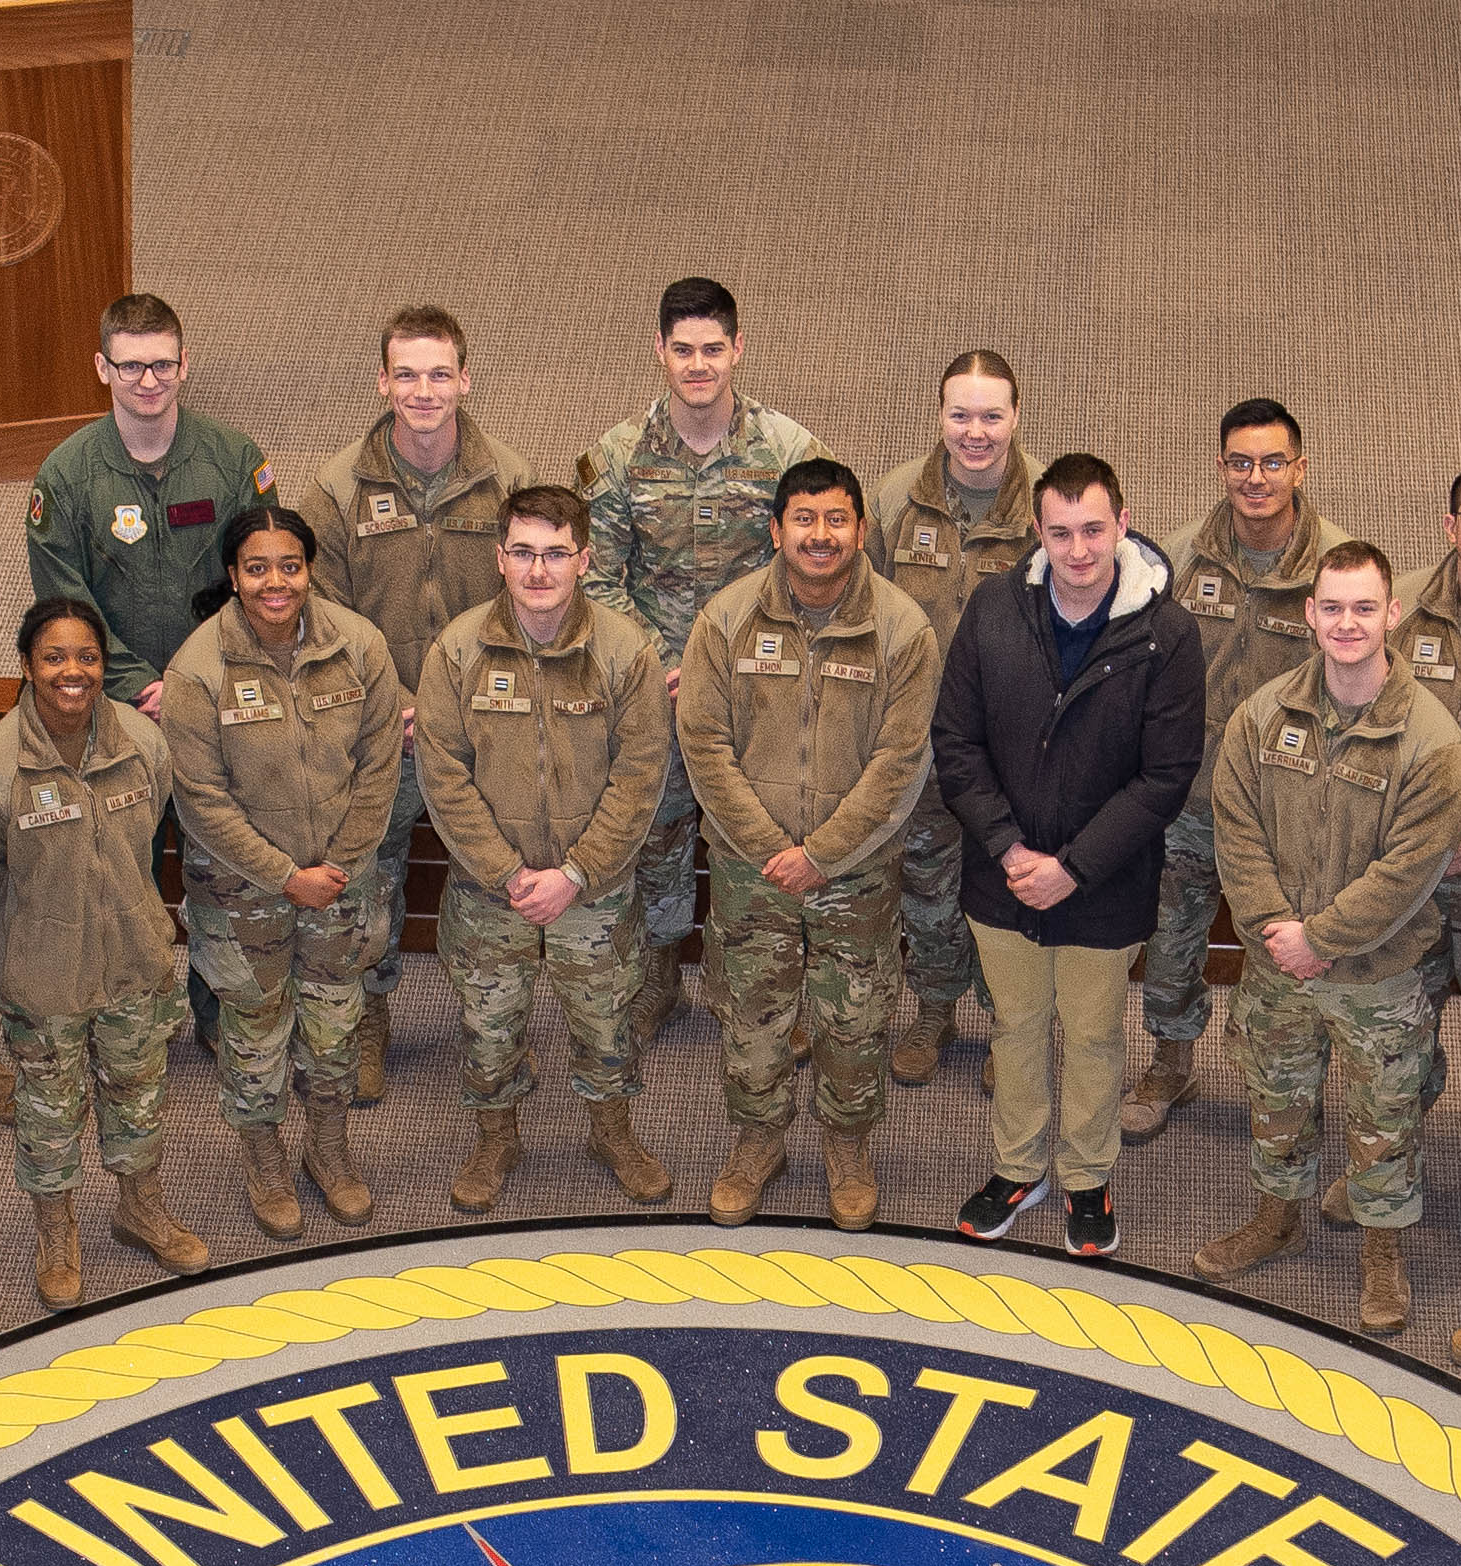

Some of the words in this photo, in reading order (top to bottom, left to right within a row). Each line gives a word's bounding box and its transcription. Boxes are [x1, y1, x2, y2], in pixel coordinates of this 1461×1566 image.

[365, 517, 408, 534] SCROGGINS
[1190, 602, 1226, 616] MONTIEL
[1258, 616, 1271, 627] U.S.
[1272, 620, 1285, 631] AIR
[1285, 623, 1308, 637] FORCE
[755, 661, 783, 673] LEMON
[835, 666, 848, 676] AIR
[849, 667, 872, 680] FORCE
[316, 696, 329, 708] U.S.
[330, 694, 343, 705] AIR
[344, 689, 363, 704] FORCE
[489, 698, 514, 710] SMITH
[233, 707, 269, 722] WILLIAMS
[1263, 753, 1311, 773] MERRIMAN
[1346, 768, 1359, 781] AIR
[1360, 772, 1383, 790] FORCE
[110, 798, 122, 810] U.S.
[123, 795, 134, 805] AIR
[134, 788, 150, 801] FORCE
[28, 808, 72, 826] CANTELON
